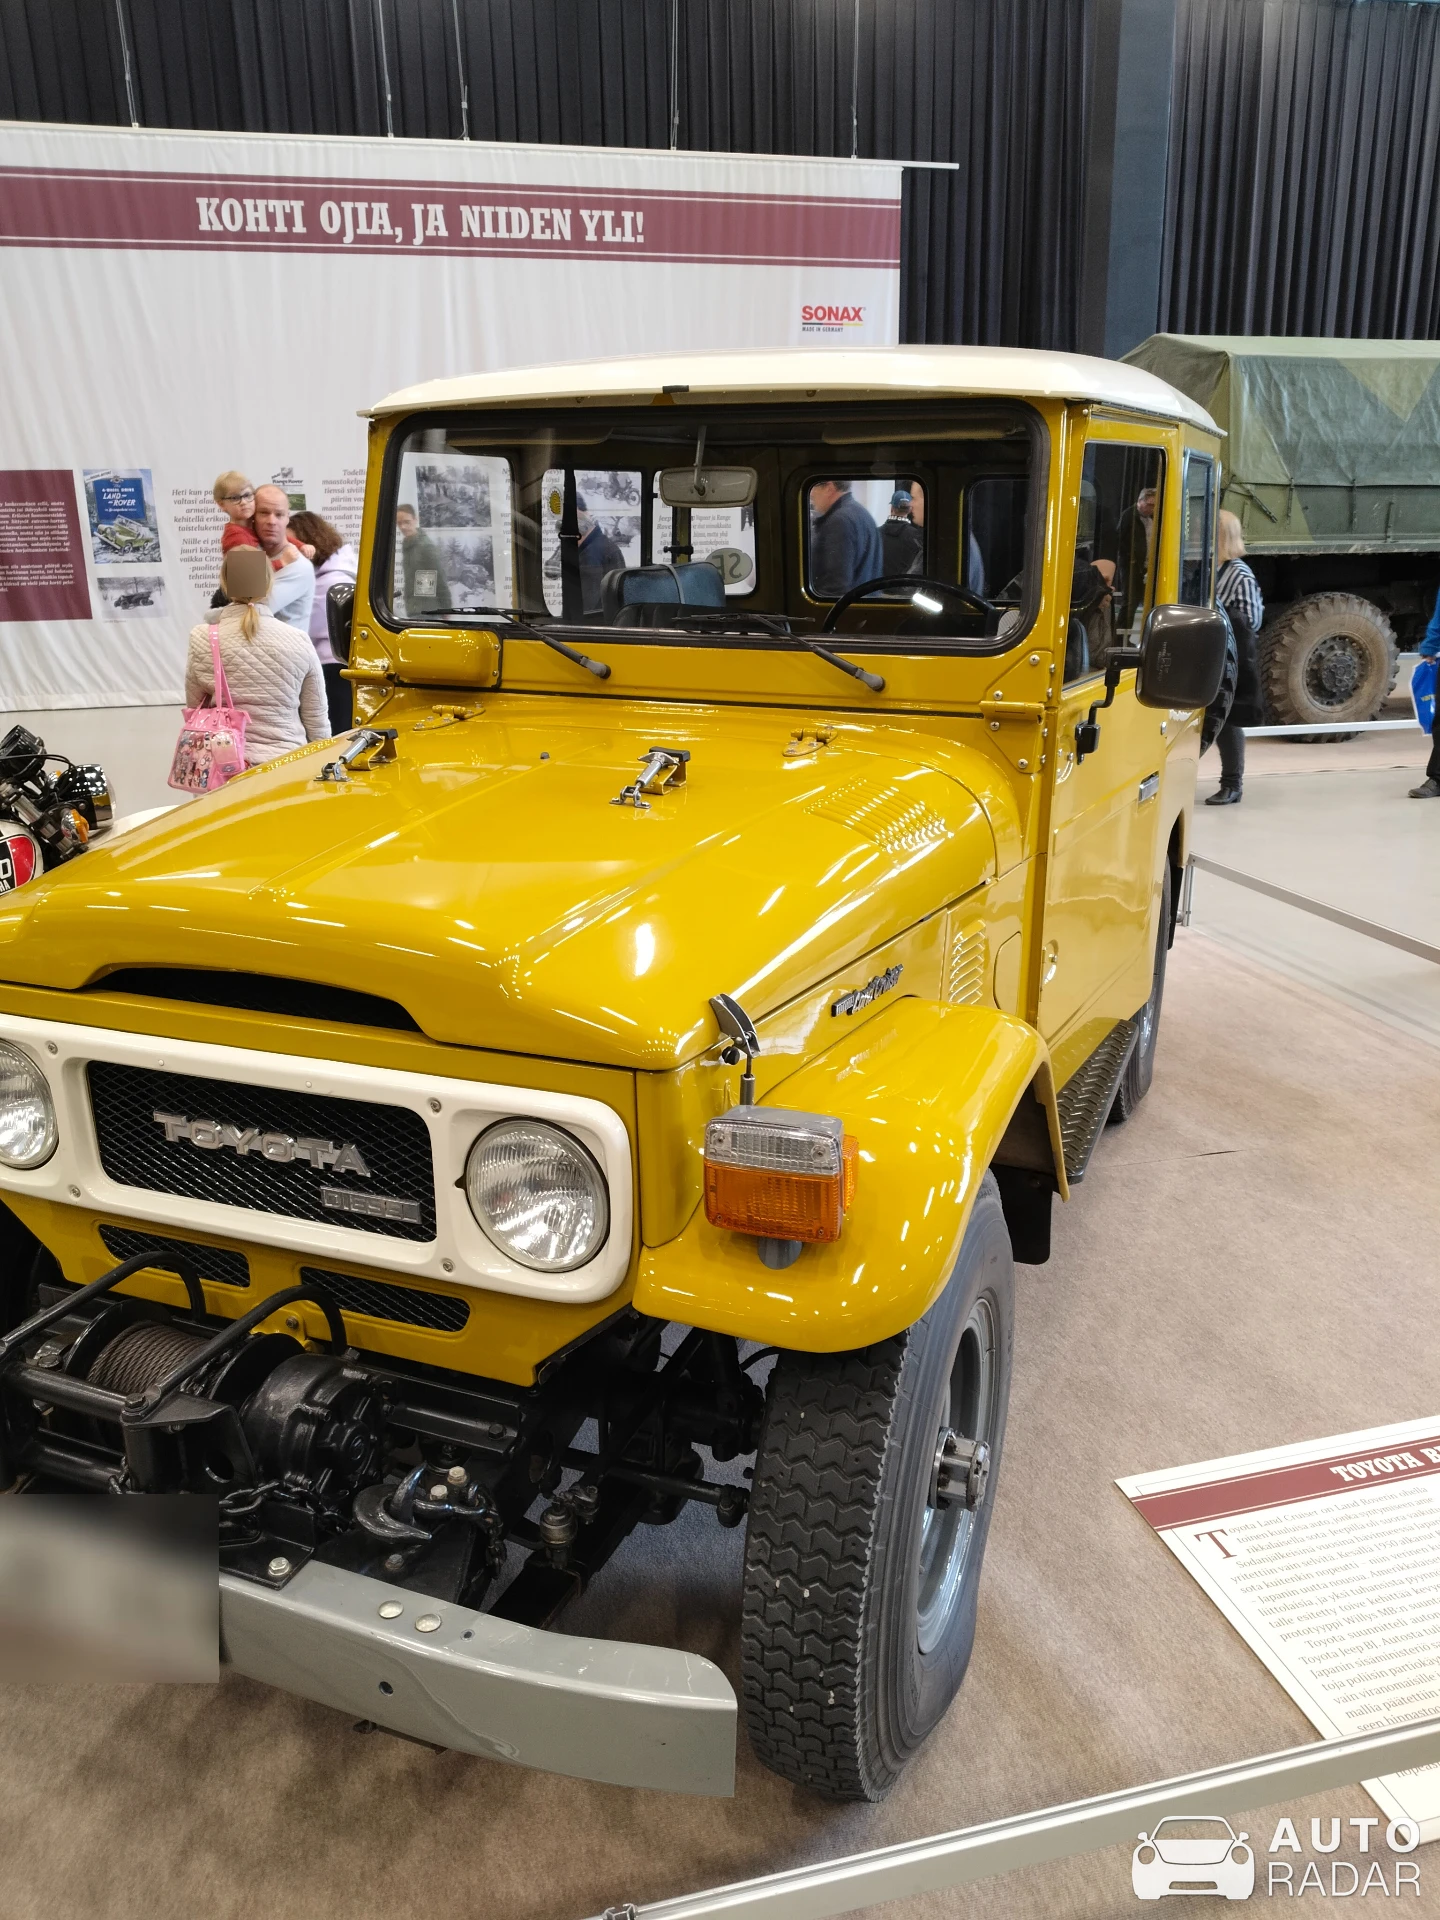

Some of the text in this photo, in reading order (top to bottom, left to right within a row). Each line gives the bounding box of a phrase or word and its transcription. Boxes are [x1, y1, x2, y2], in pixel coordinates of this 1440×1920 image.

[196, 198, 645, 246] KOHTI OJIA, JA NIIDEN YLI!
[801, 305, 864, 322] SONAX
[173, 497, 197, 505] valtasi
[188, 488, 202, 496] kun
[173, 515, 204, 523] kehitellä
[180, 546, 197, 554] juuri
[182, 537, 202, 545] Niille
[153, 1110, 371, 1178] TOYOTA
[1329, 1452, 1425, 1482] TOYOTA
[1236, 1531, 1268, 1544] toinen
[1267, 1522, 1309, 1537] kuuluisa
[1309, 1518, 1334, 1529] auto,
[1333, 1512, 1359, 1526] jonka
[1358, 1500, 1415, 1518] syntymiseen
[1256, 1516, 1283, 1528] Land
[1283, 1508, 1319, 1522] Cruiser
[1320, 1506, 1335, 1514] on
[1334, 1499, 1360, 1511] Land
[1360, 1492, 1398, 1506] Roverin
[1398, 1486, 1429, 1497] ohella
[1235, 1545, 1316, 1569] Sodanjälkeisinä
[1315, 1538, 1355, 1551] vuosina
[1353, 1525, 1415, 1543] hävinneessä
[1245, 1535, 1305, 1554] rikkalaisella
[1365, 1518, 1380, 1529] oli
[1379, 1514, 1407, 1525] suora
[1230, 1567, 1278, 1584] yritettiin
[1277, 1562, 1301, 1572] vain
[1301, 1552, 1338, 1568] selvitä.
[1373, 1538, 1399, 1551] 1950
[1398, 1531, 1436, 1546] alkanut
[1240, 1584, 1264, 1594] sota
[1262, 1573, 1315, 1588] kuitenkin
[1314, 1560, 1360, 1577] nopeutti
[1368, 1555, 1391, 1565] niin
[1390, 1546, 1429, 1560] verinen
[1257, 1588, 1300, 1605] Japanin
[1299, 1582, 1329, 1594] uutta
[1328, 1573, 1370, 1587] nousua.
[1257, 1598, 1318, 1617] liittolaisia,
[1315, 1595, 1329, 1605] ja
[1328, 1588, 1350, 1603] yksi
[1349, 1578, 1405, 1596] tuhansista
[1268, 1616, 1295, 1629] talle
[1296, 1607, 1338, 1622] esitetty
[1338, 1601, 1367, 1612] toive
[1366, 1588, 1413, 1606] kehittää
[1279, 1618, 1344, 1643] prototyyppi
[1341, 1611, 1379, 1625] Willys
[1376, 1604, 1409, 1617] MB:n
[1298, 1648, 1340, 1666] Toyota
[1337, 1643, 1364, 1657] Jeep
[1381, 1630, 1424, 1646] Autosta
[1303, 1634, 1346, 1649] Toyota
[1347, 1617, 1409, 1640] suunnitteli
[1309, 1661, 1355, 1680] Japanin
[1354, 1641, 1431, 1668] sisäministeriö
[1321, 1678, 1347, 1692] toja
[1345, 1668, 1390, 1688] poliisin
[1332, 1671, 1438, 1705] vain viranomaisille
[1345, 1685, 1439, 1719] mallia päätettiin
[1356, 1718, 1385, 1733] seen
